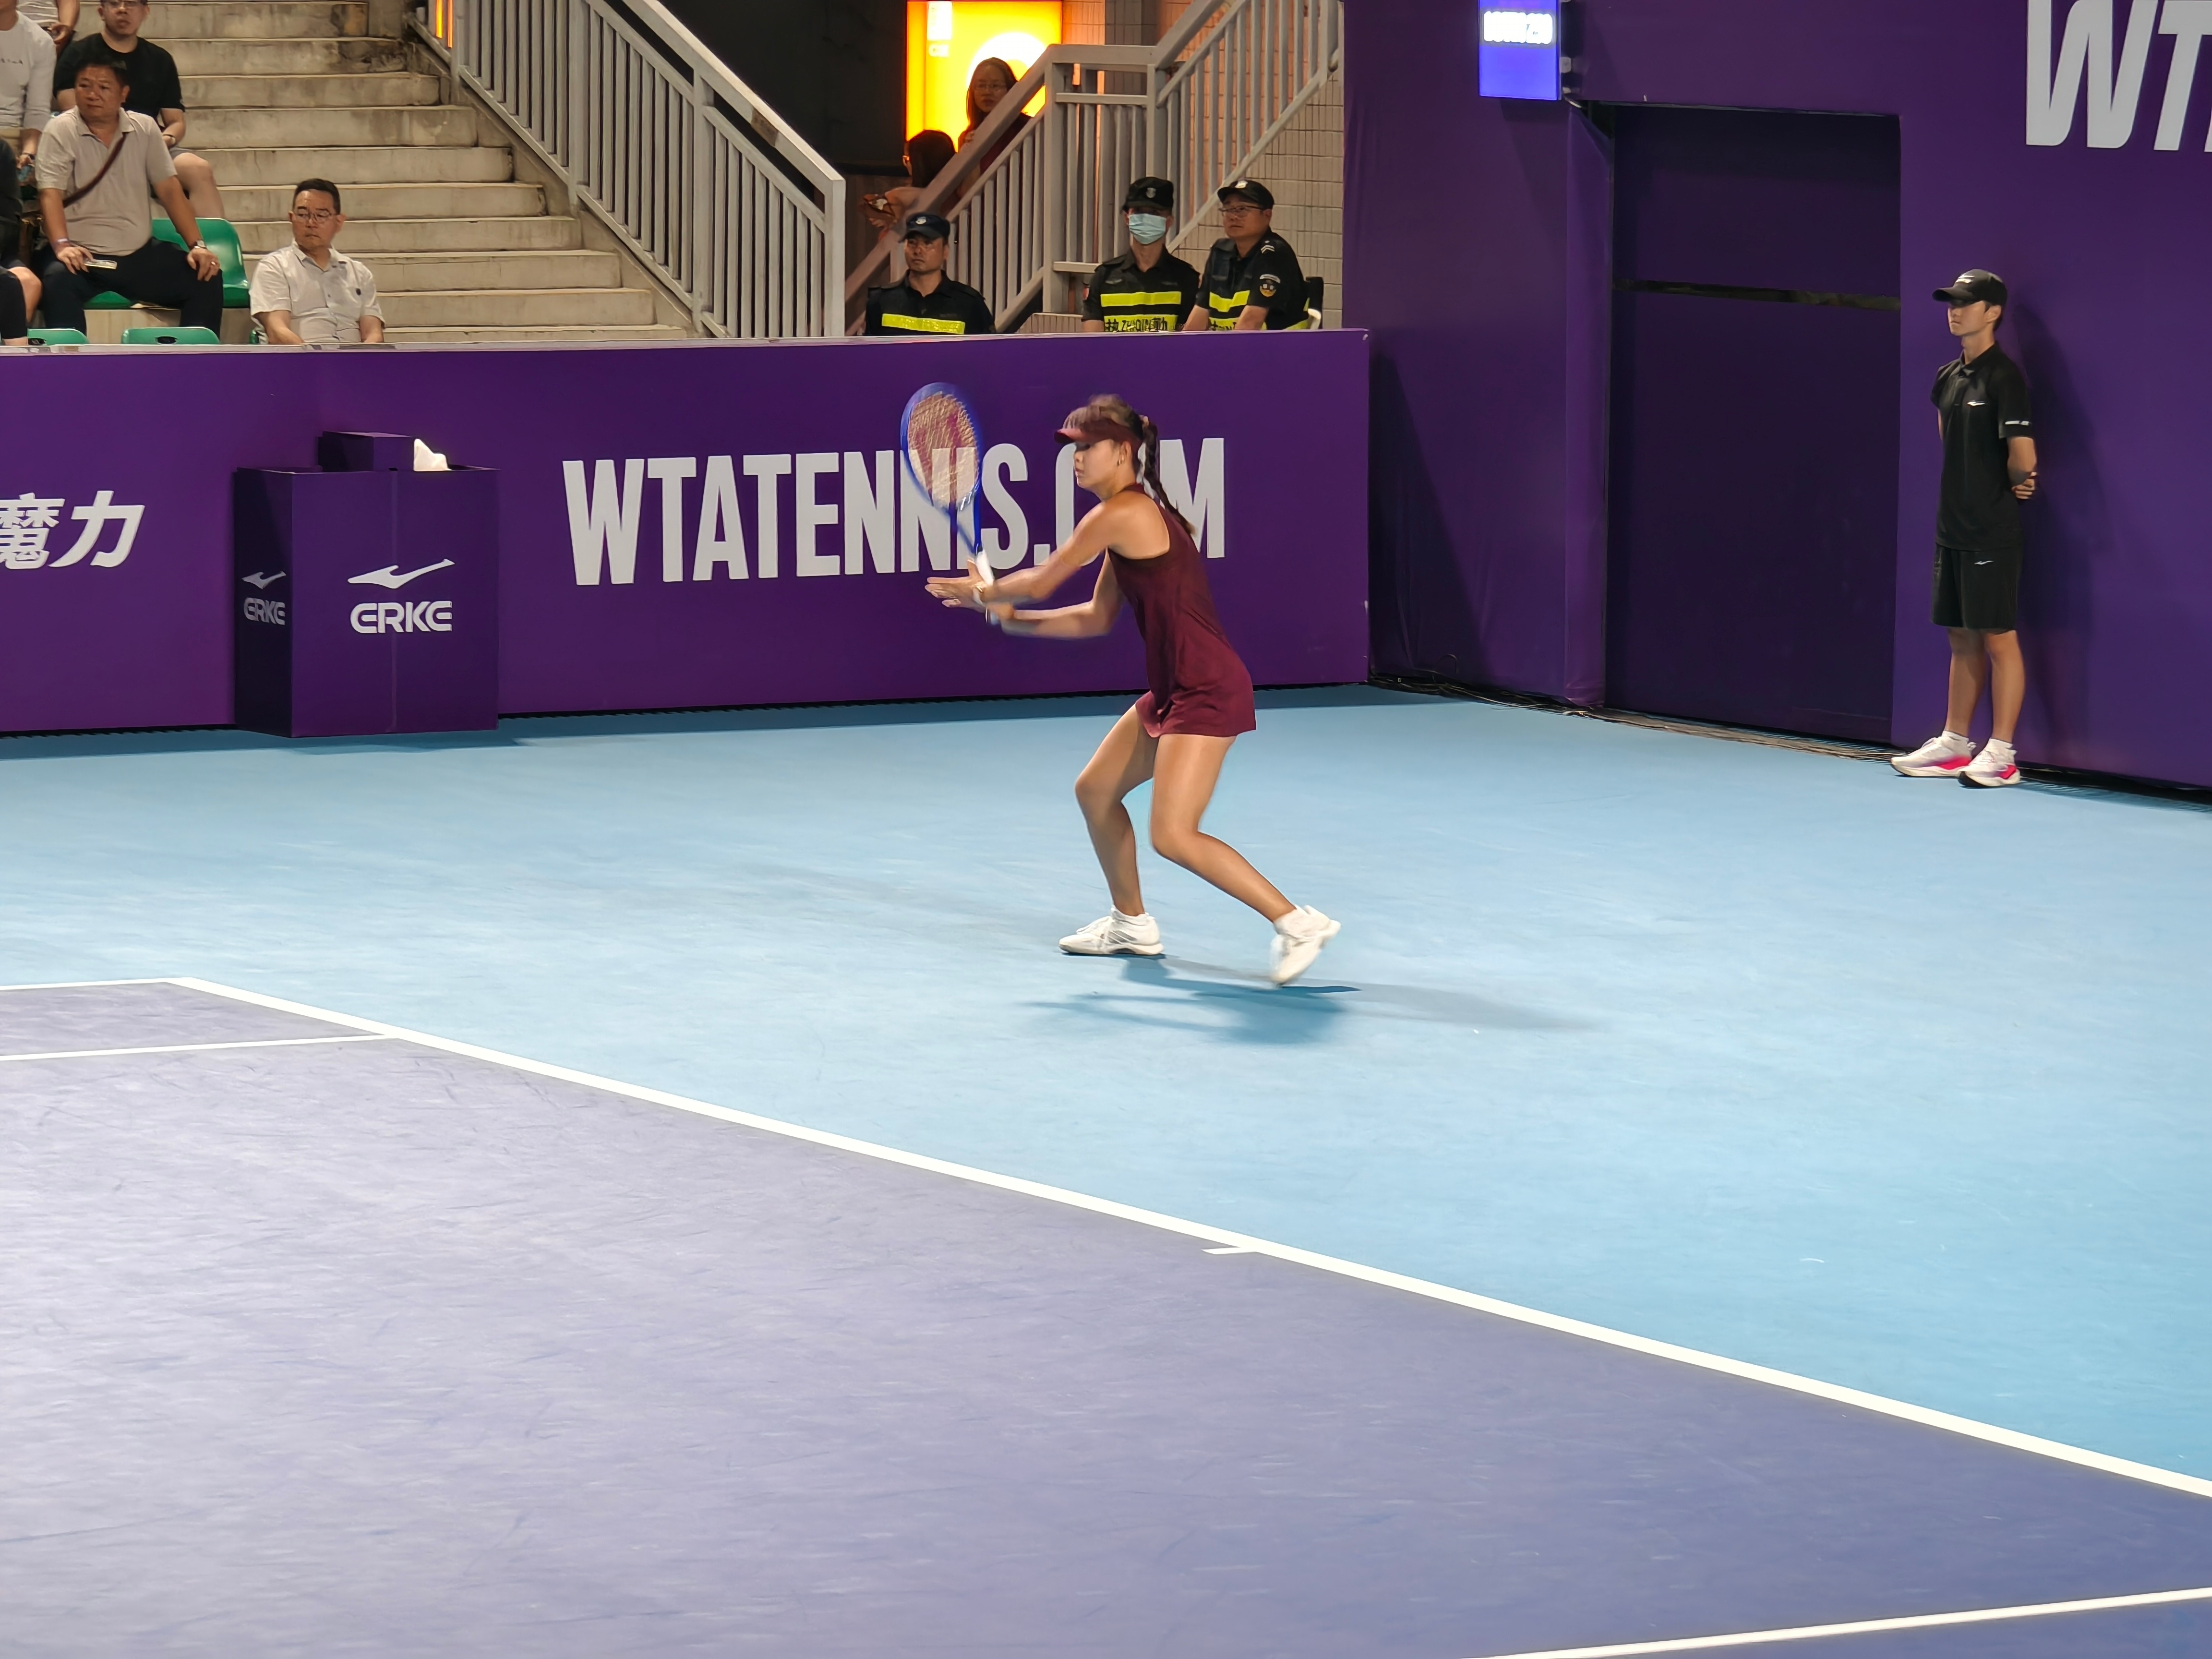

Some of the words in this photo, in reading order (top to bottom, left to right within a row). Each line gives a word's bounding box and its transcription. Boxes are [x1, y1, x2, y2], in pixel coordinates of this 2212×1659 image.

[2026, 0, 2212, 152] WT
[0, 491, 145, 569] 魔力
[563, 438, 1225, 586] WTATENNIS.CM
[244, 598, 286, 625] ERKE
[351, 601, 452, 633] ERKE
